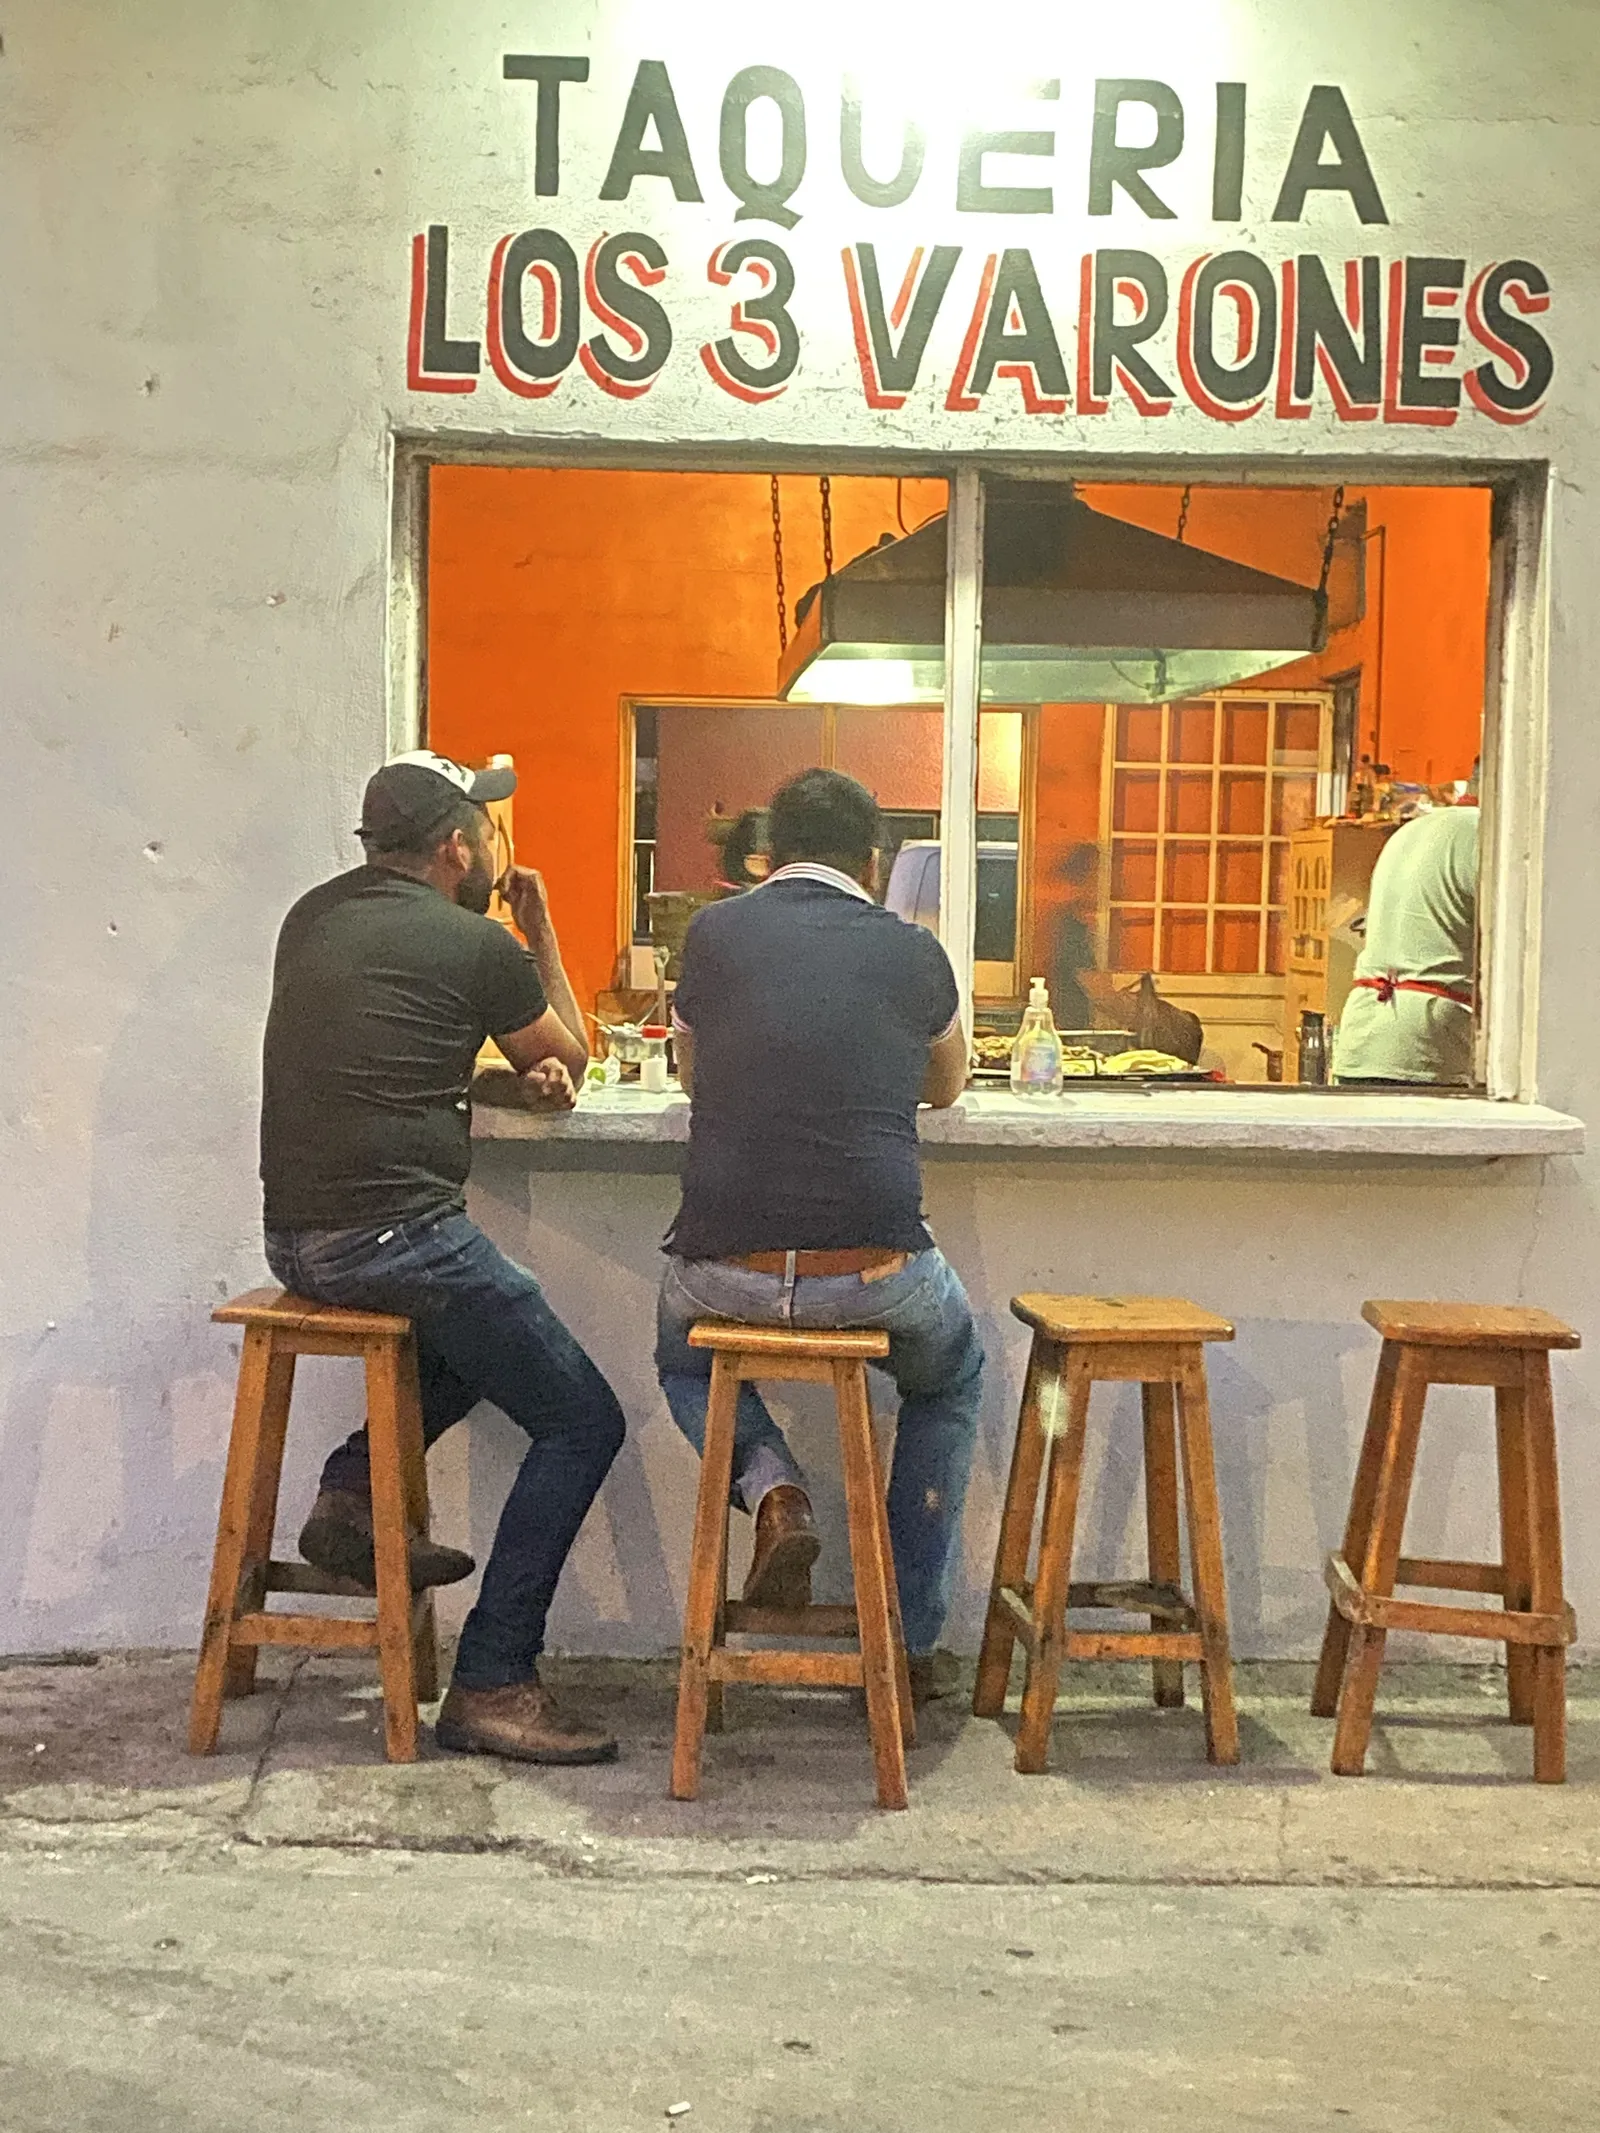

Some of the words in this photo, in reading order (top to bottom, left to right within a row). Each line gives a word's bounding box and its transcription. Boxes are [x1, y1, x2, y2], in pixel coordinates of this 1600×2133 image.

[503, 54, 1390, 230] TAQUERIA
[407, 225, 672, 399] LOS
[700, 239, 800, 404] 3
[840, 242, 1554, 426] VARONES
